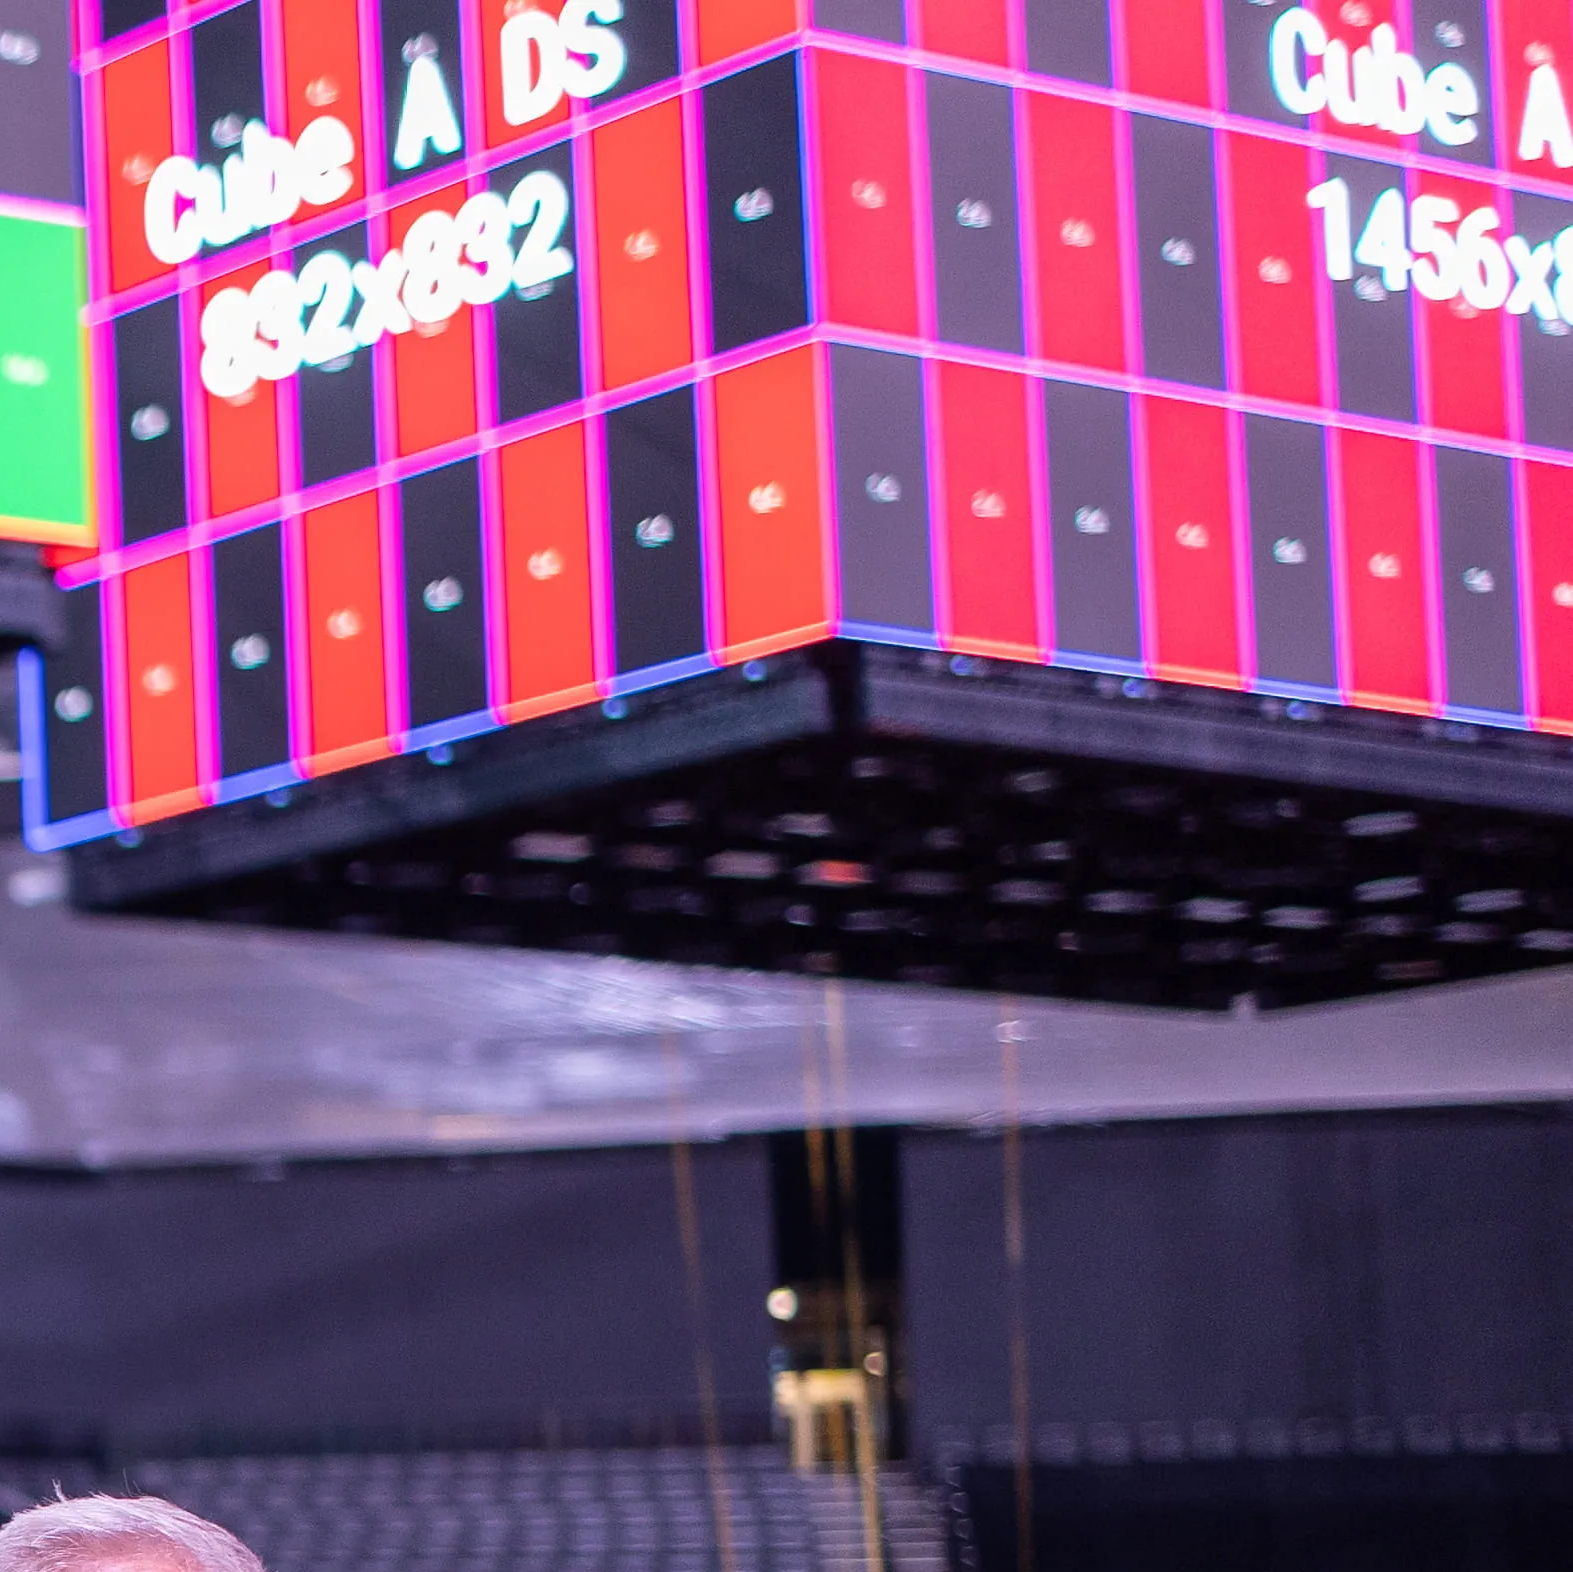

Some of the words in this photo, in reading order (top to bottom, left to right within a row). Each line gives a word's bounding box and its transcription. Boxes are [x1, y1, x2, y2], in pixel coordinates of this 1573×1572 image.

[145, 116, 354, 264] Cube
[393, 57, 463, 170] A
[500, 0, 626, 126] DS
[1270, 6, 1479, 146] Cube
[1517, 63, 1573, 168] A
[201, 171, 574, 397] 832x832
